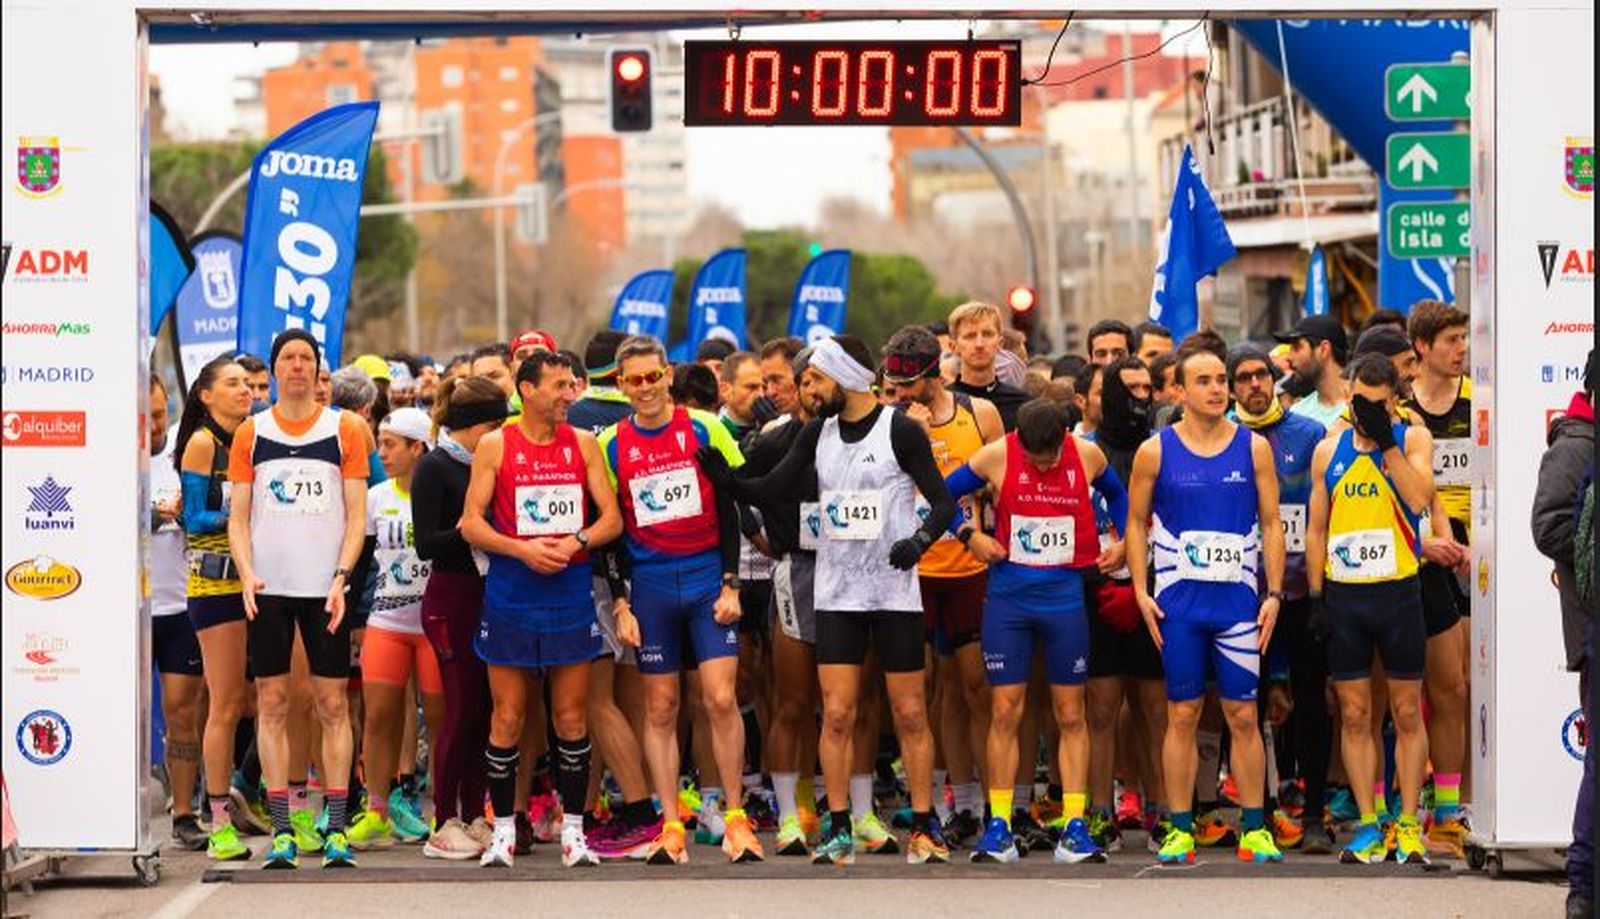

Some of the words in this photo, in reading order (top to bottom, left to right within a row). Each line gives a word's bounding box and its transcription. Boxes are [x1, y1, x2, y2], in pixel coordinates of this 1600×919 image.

[723, 50, 1007, 116] 10:00:00
[1400, 210, 1446, 227] calle
[1400, 229, 1443, 248] Isla
[15, 250, 88, 275] ADM
[19, 367, 95, 382] MADRID
[23, 416, 80, 440] alquiber
[1442, 453, 1468, 468] 210
[294, 481, 323, 496] 713
[664, 485, 691, 502] 697
[1344, 482, 1379, 497] UCA
[548, 501, 574, 516] 001
[843, 506, 877, 520] 1421
[25, 517, 75, 530] luanvi
[1041, 532, 1068, 548] 015
[1360, 545, 1388, 560] 867
[411, 564, 429, 578] 56
